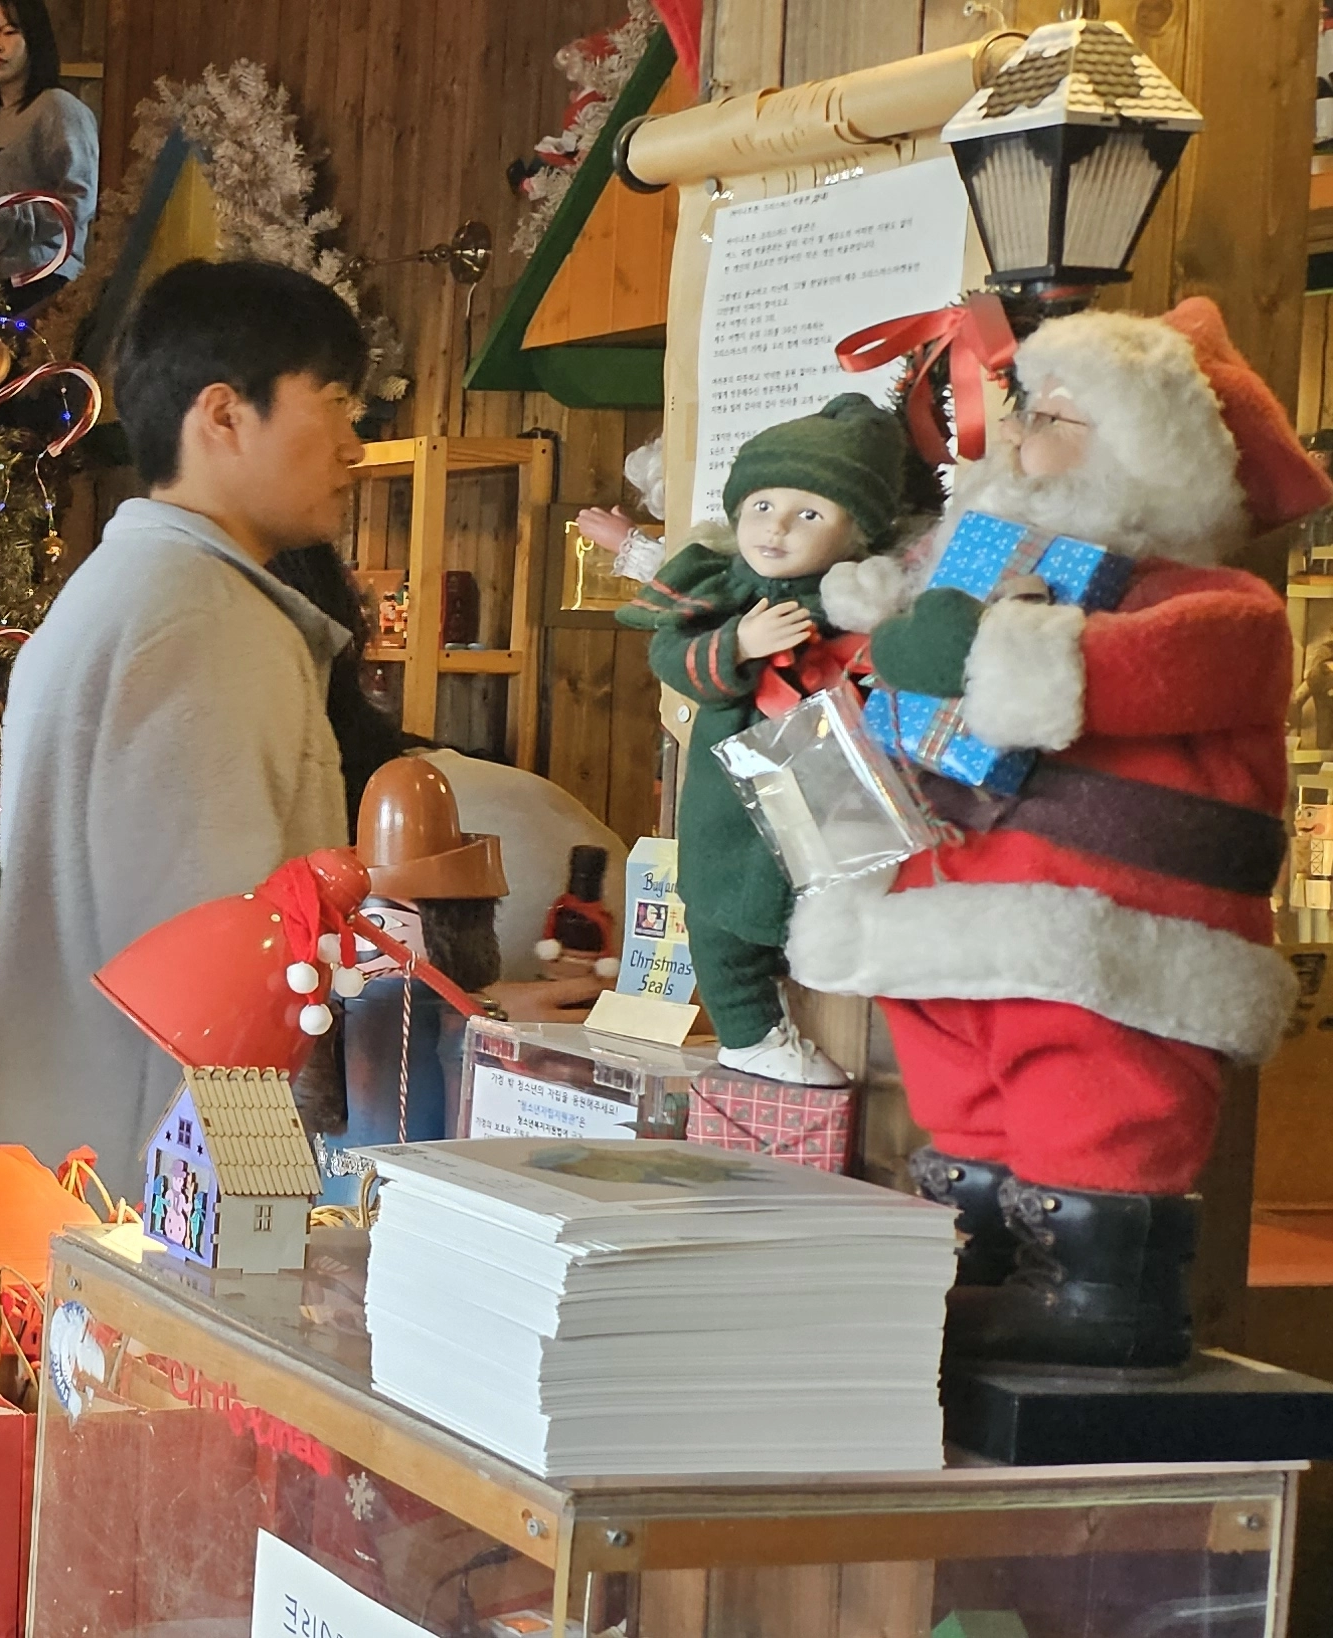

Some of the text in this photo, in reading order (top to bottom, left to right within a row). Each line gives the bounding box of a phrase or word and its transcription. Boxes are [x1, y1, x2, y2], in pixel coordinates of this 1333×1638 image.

[630, 950, 693, 976] Christmas
[637, 974, 675, 996] Seals
[491, 1072, 503, 1086] 가정
[517, 1079, 544, 1097] 청소년의
[547, 1087, 569, 1104] 자립을
